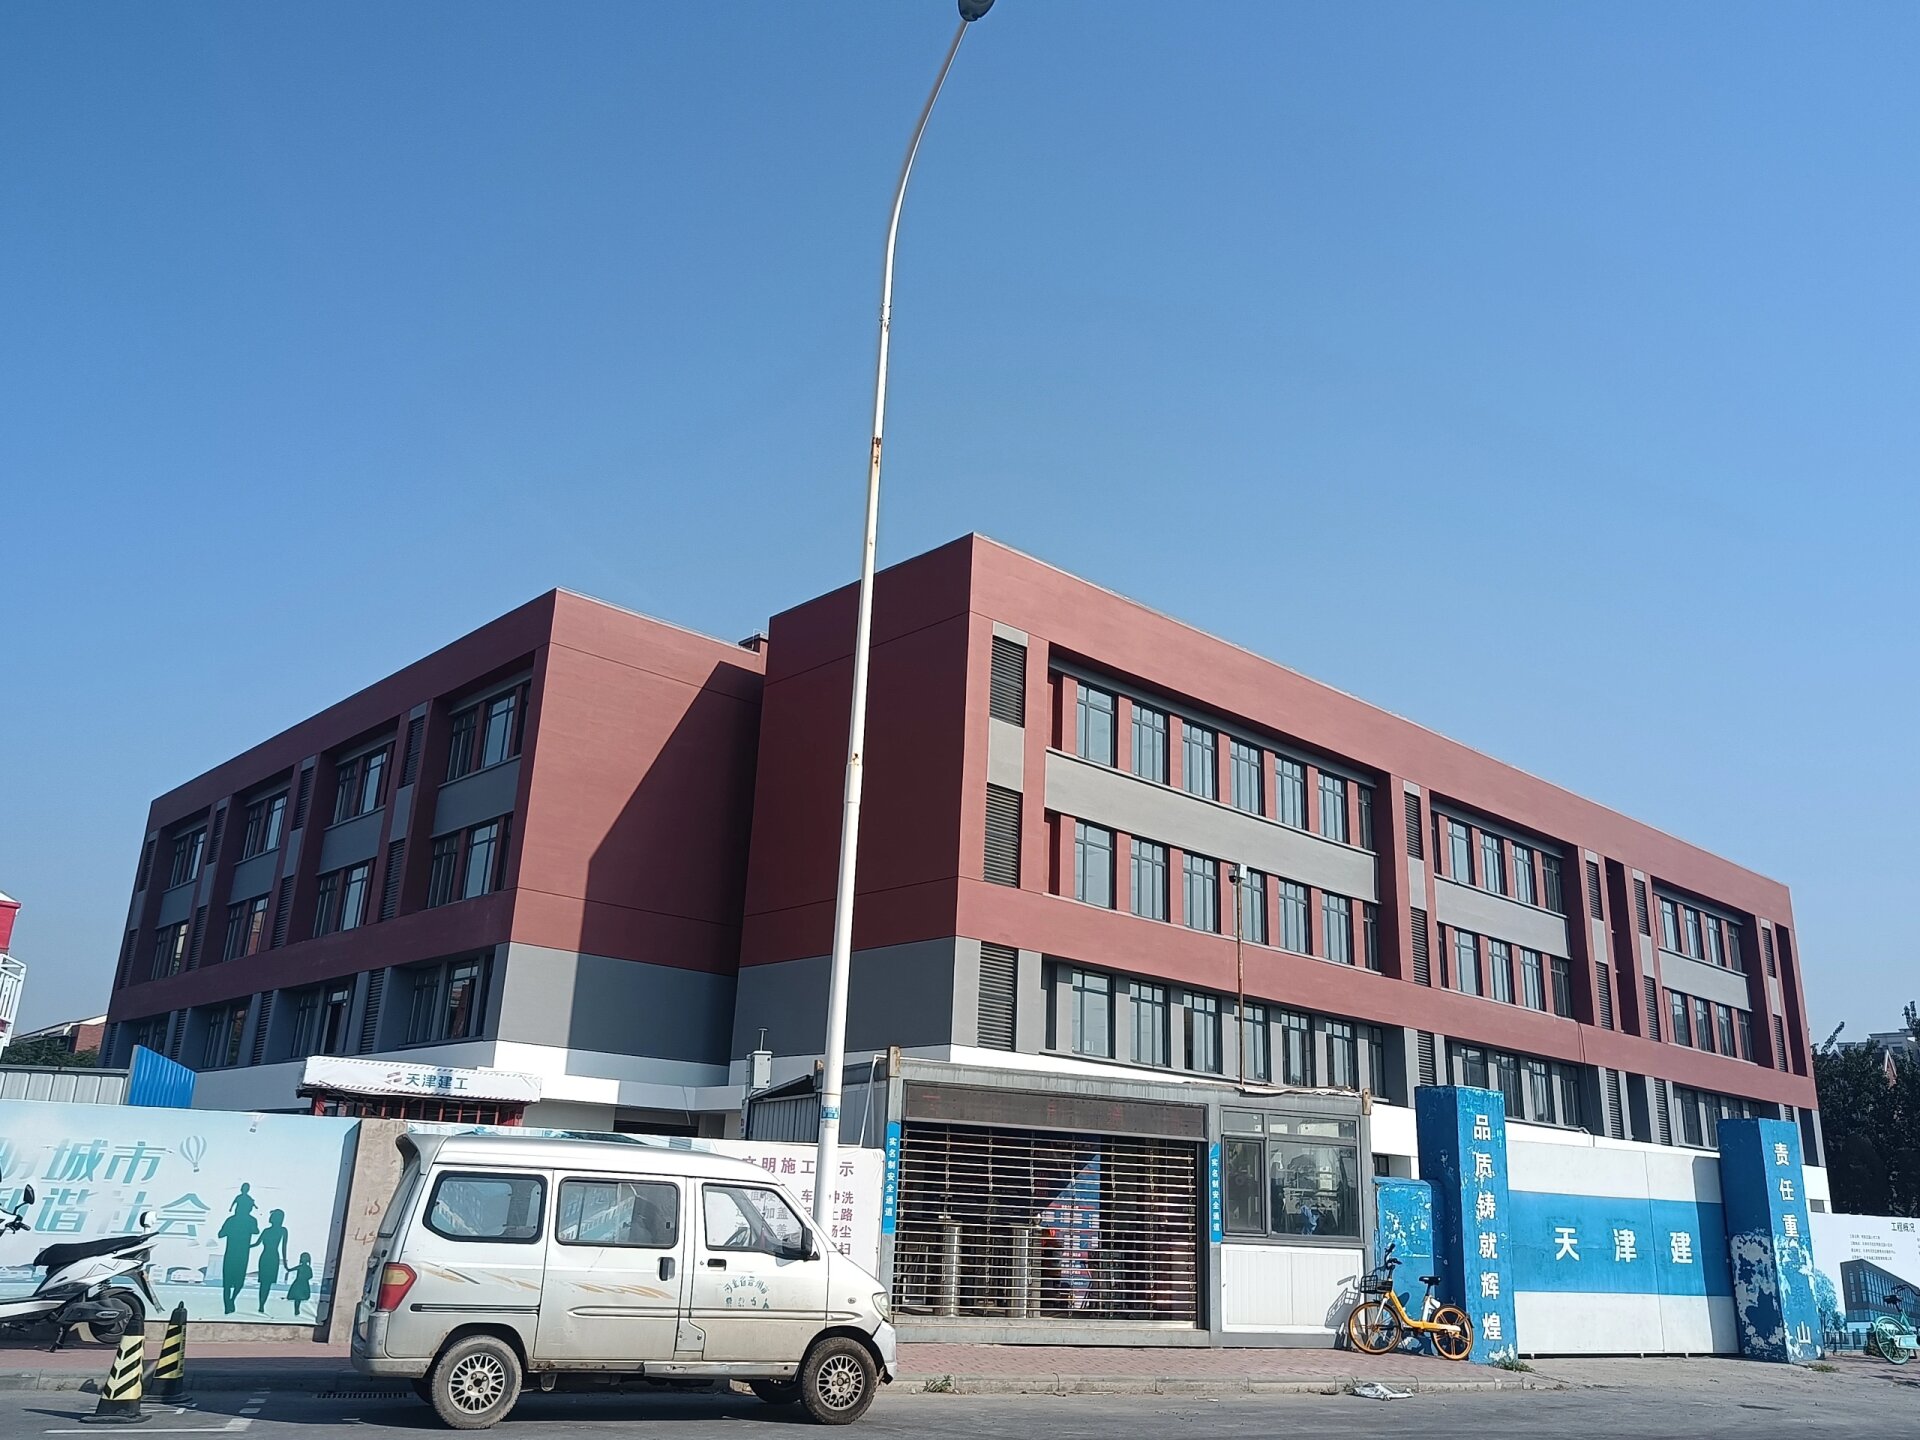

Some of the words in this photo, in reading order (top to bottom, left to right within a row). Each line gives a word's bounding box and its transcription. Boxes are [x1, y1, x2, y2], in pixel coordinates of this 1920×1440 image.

[405, 1073, 468, 1090] 天津建工
[742, 1156, 854, 1177] 明施工示
[885, 1137, 898, 1217] 实名制安全通道
[1473, 1114, 1502, 1341] 品质铸就辉煌
[1554, 1227, 1694, 1264] 天津建
[1774, 1142, 1812, 1344] 责任重泰山
